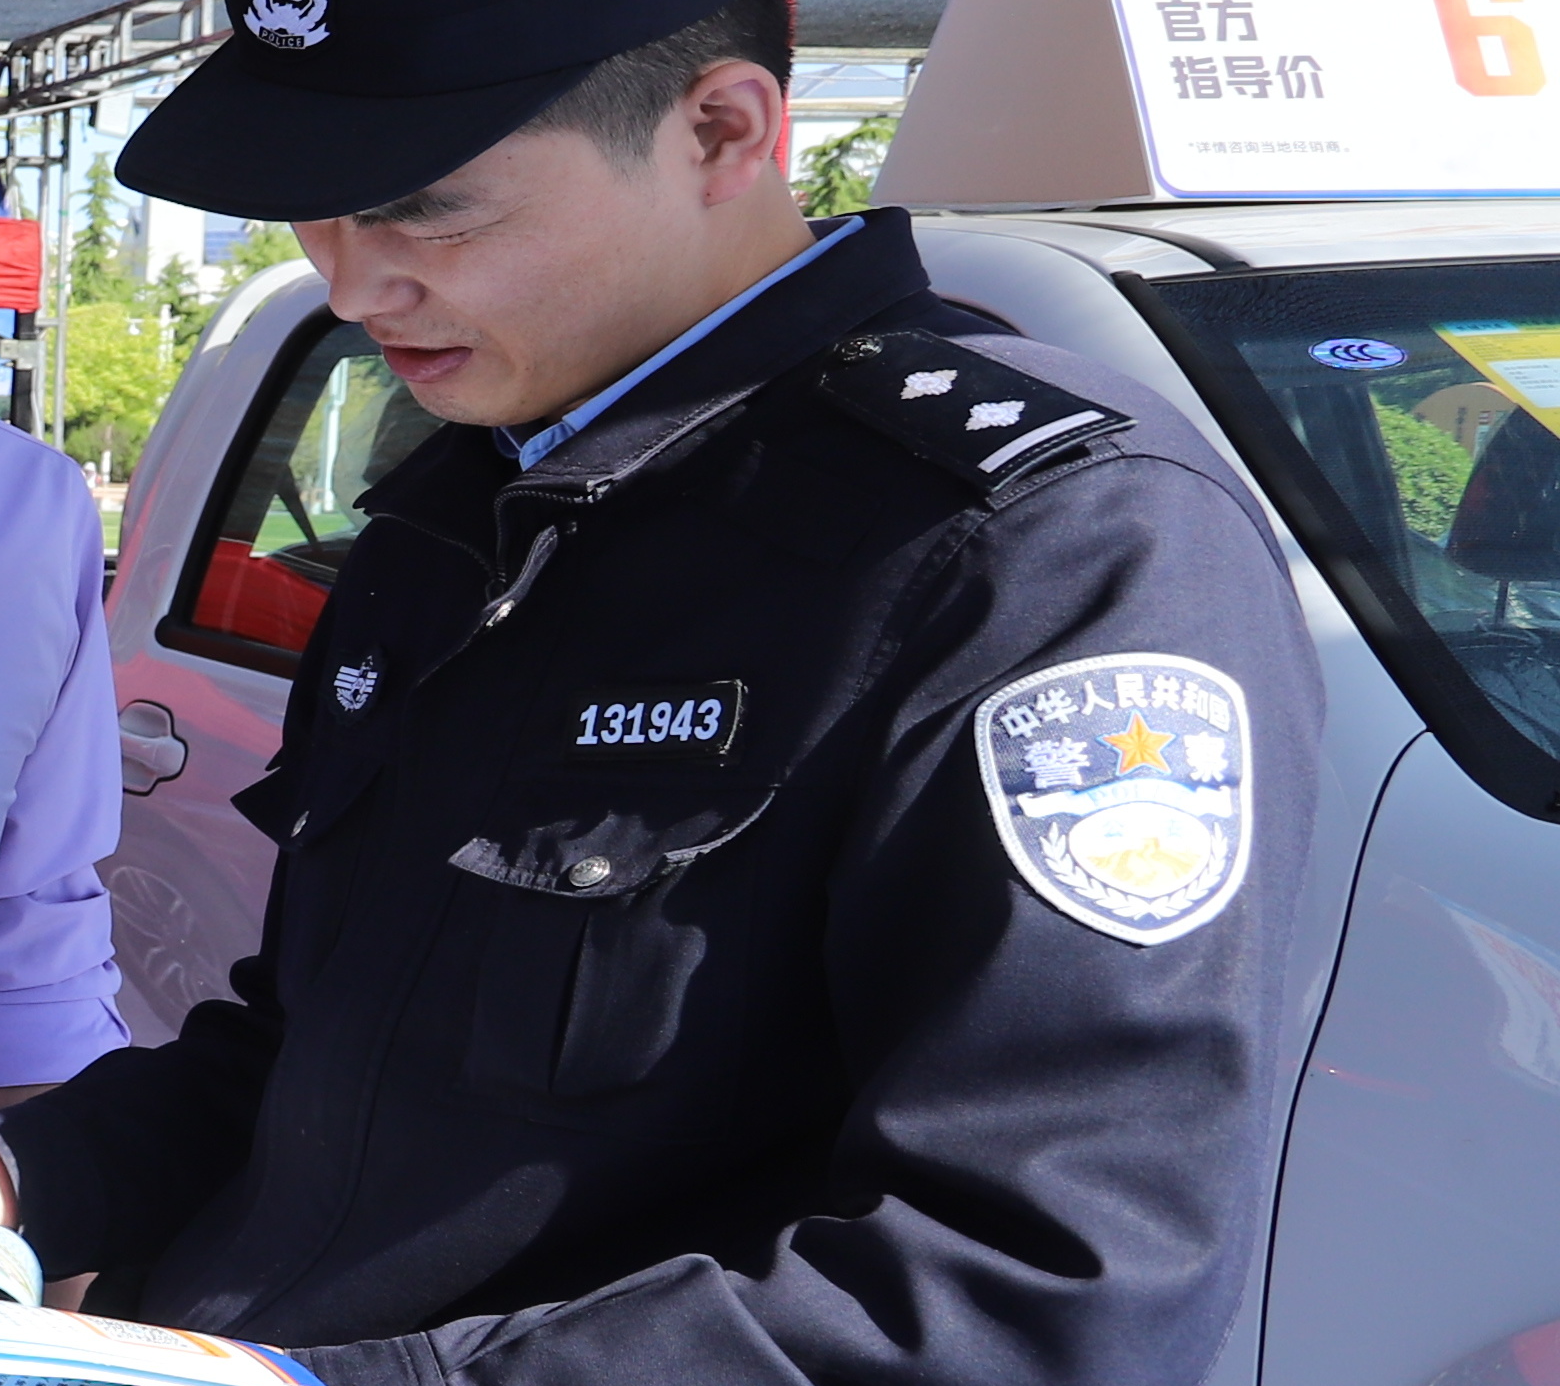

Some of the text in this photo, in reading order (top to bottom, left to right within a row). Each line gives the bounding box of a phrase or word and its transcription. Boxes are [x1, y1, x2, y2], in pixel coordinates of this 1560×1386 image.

[261, 29, 302, 47] POLICE
[1170, 54, 1325, 100] 指导价
[575, 699, 721, 746] 131943
[999, 672, 1232, 739] 中华人民共和国
[1023, 736, 1091, 789] 警
